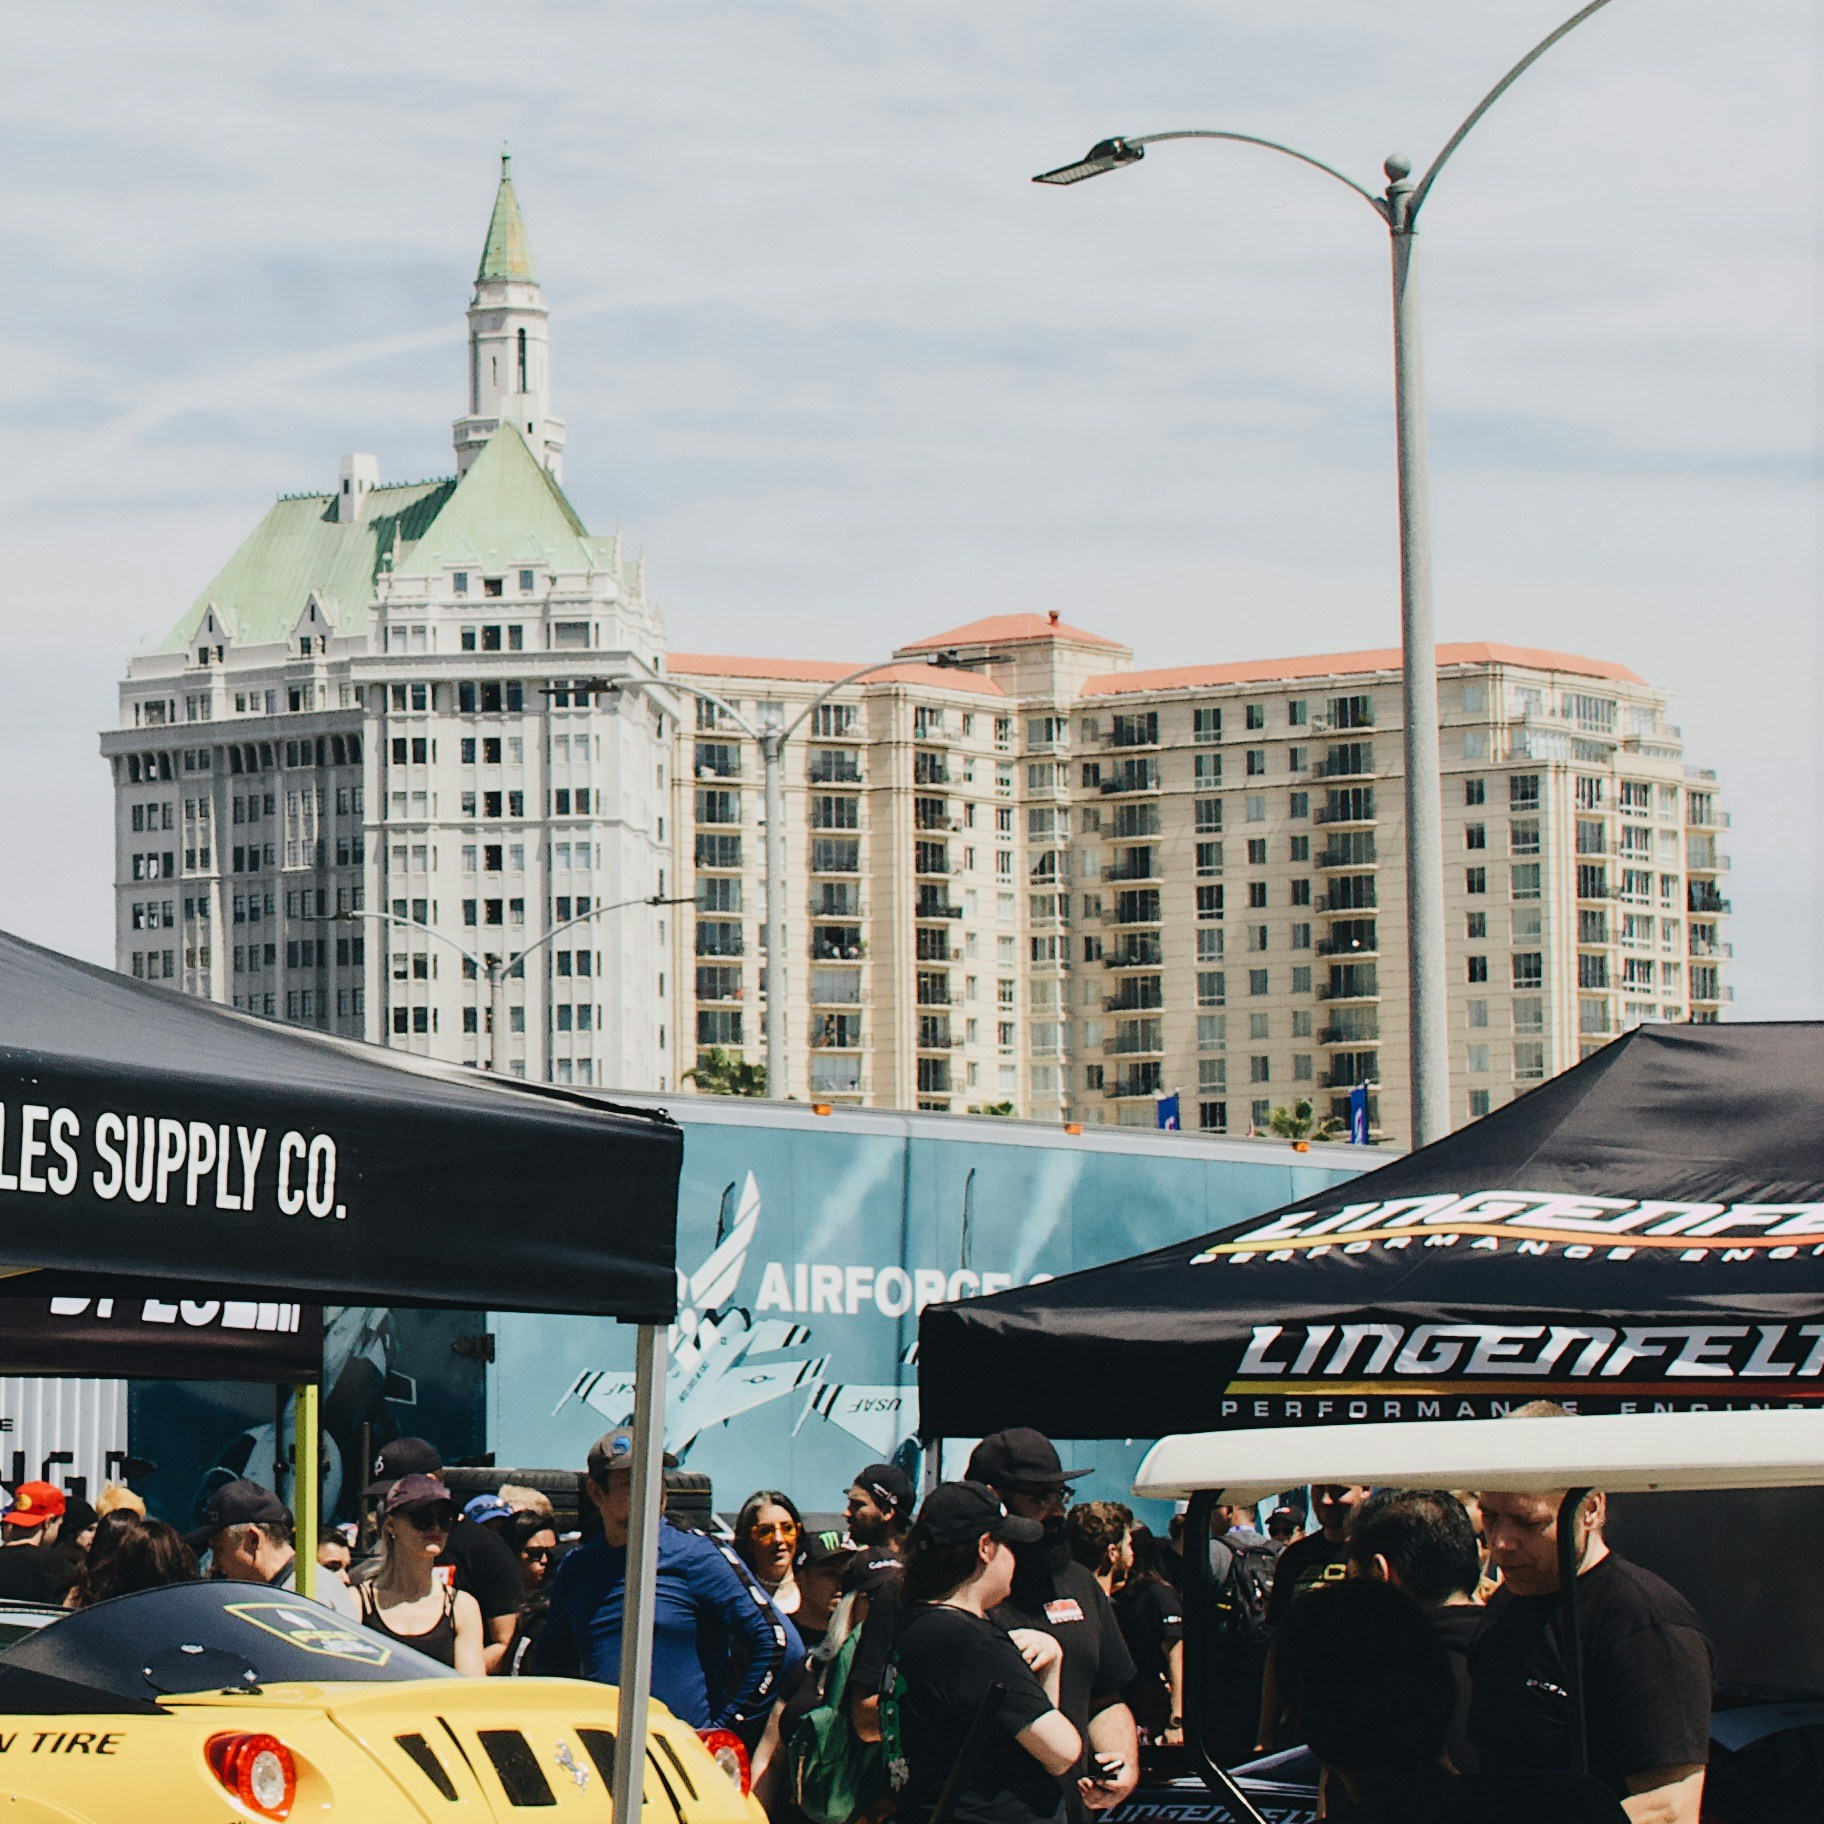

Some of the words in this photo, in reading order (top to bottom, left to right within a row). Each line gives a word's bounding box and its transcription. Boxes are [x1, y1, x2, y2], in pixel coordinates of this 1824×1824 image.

[92, 1111, 267, 1212] SUPPLY
[277, 1129, 347, 1220] CO.
[1189, 1233, 1637, 1267] PERFORMANCE
[29, 1731, 128, 1756] TIRE
